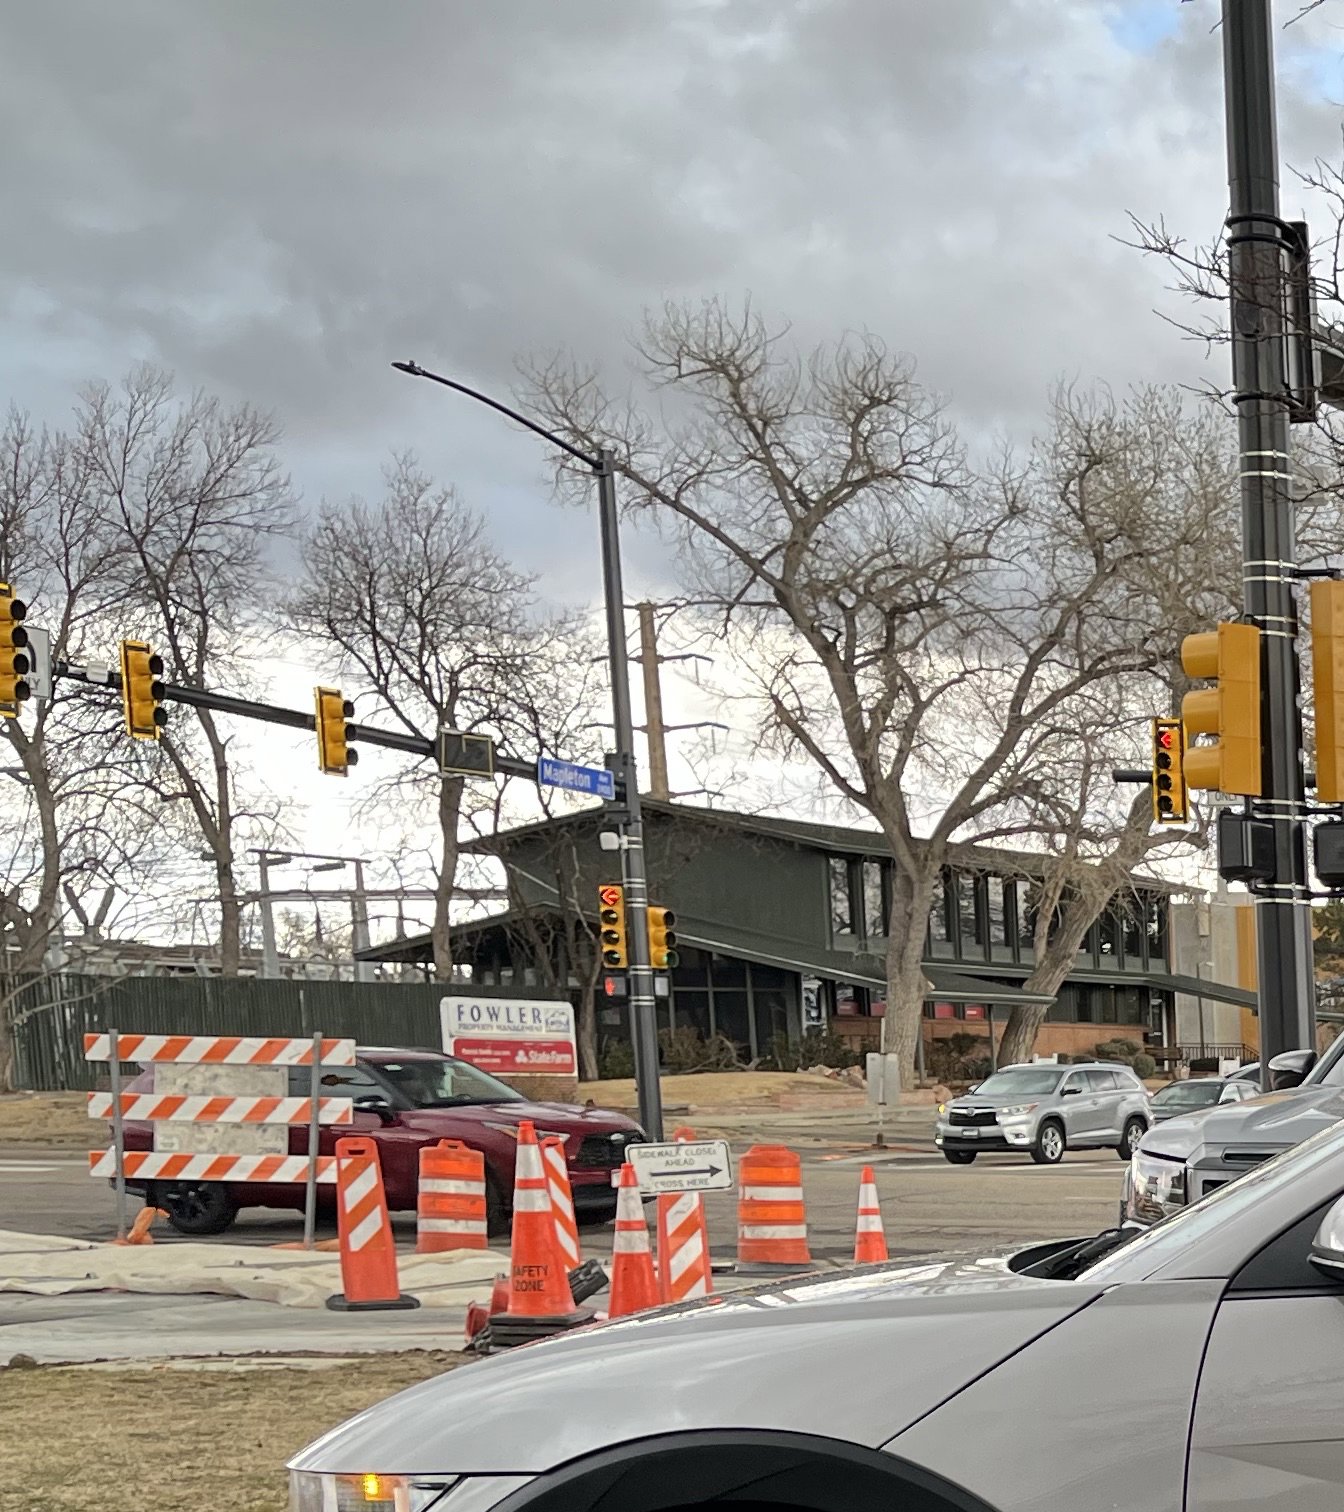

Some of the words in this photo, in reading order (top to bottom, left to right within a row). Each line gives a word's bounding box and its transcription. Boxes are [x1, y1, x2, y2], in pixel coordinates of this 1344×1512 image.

[543, 761, 591, 788] Mapleton
[457, 1004, 542, 1024] FOWLER
[638, 1149, 681, 1159] SIDEWALK
[664, 1158, 695, 1167] AHEAD
[654, 1179, 684, 1189] CROSS
[687, 1178, 709, 1187] HERE
[515, 1279, 545, 1292] ZONE
